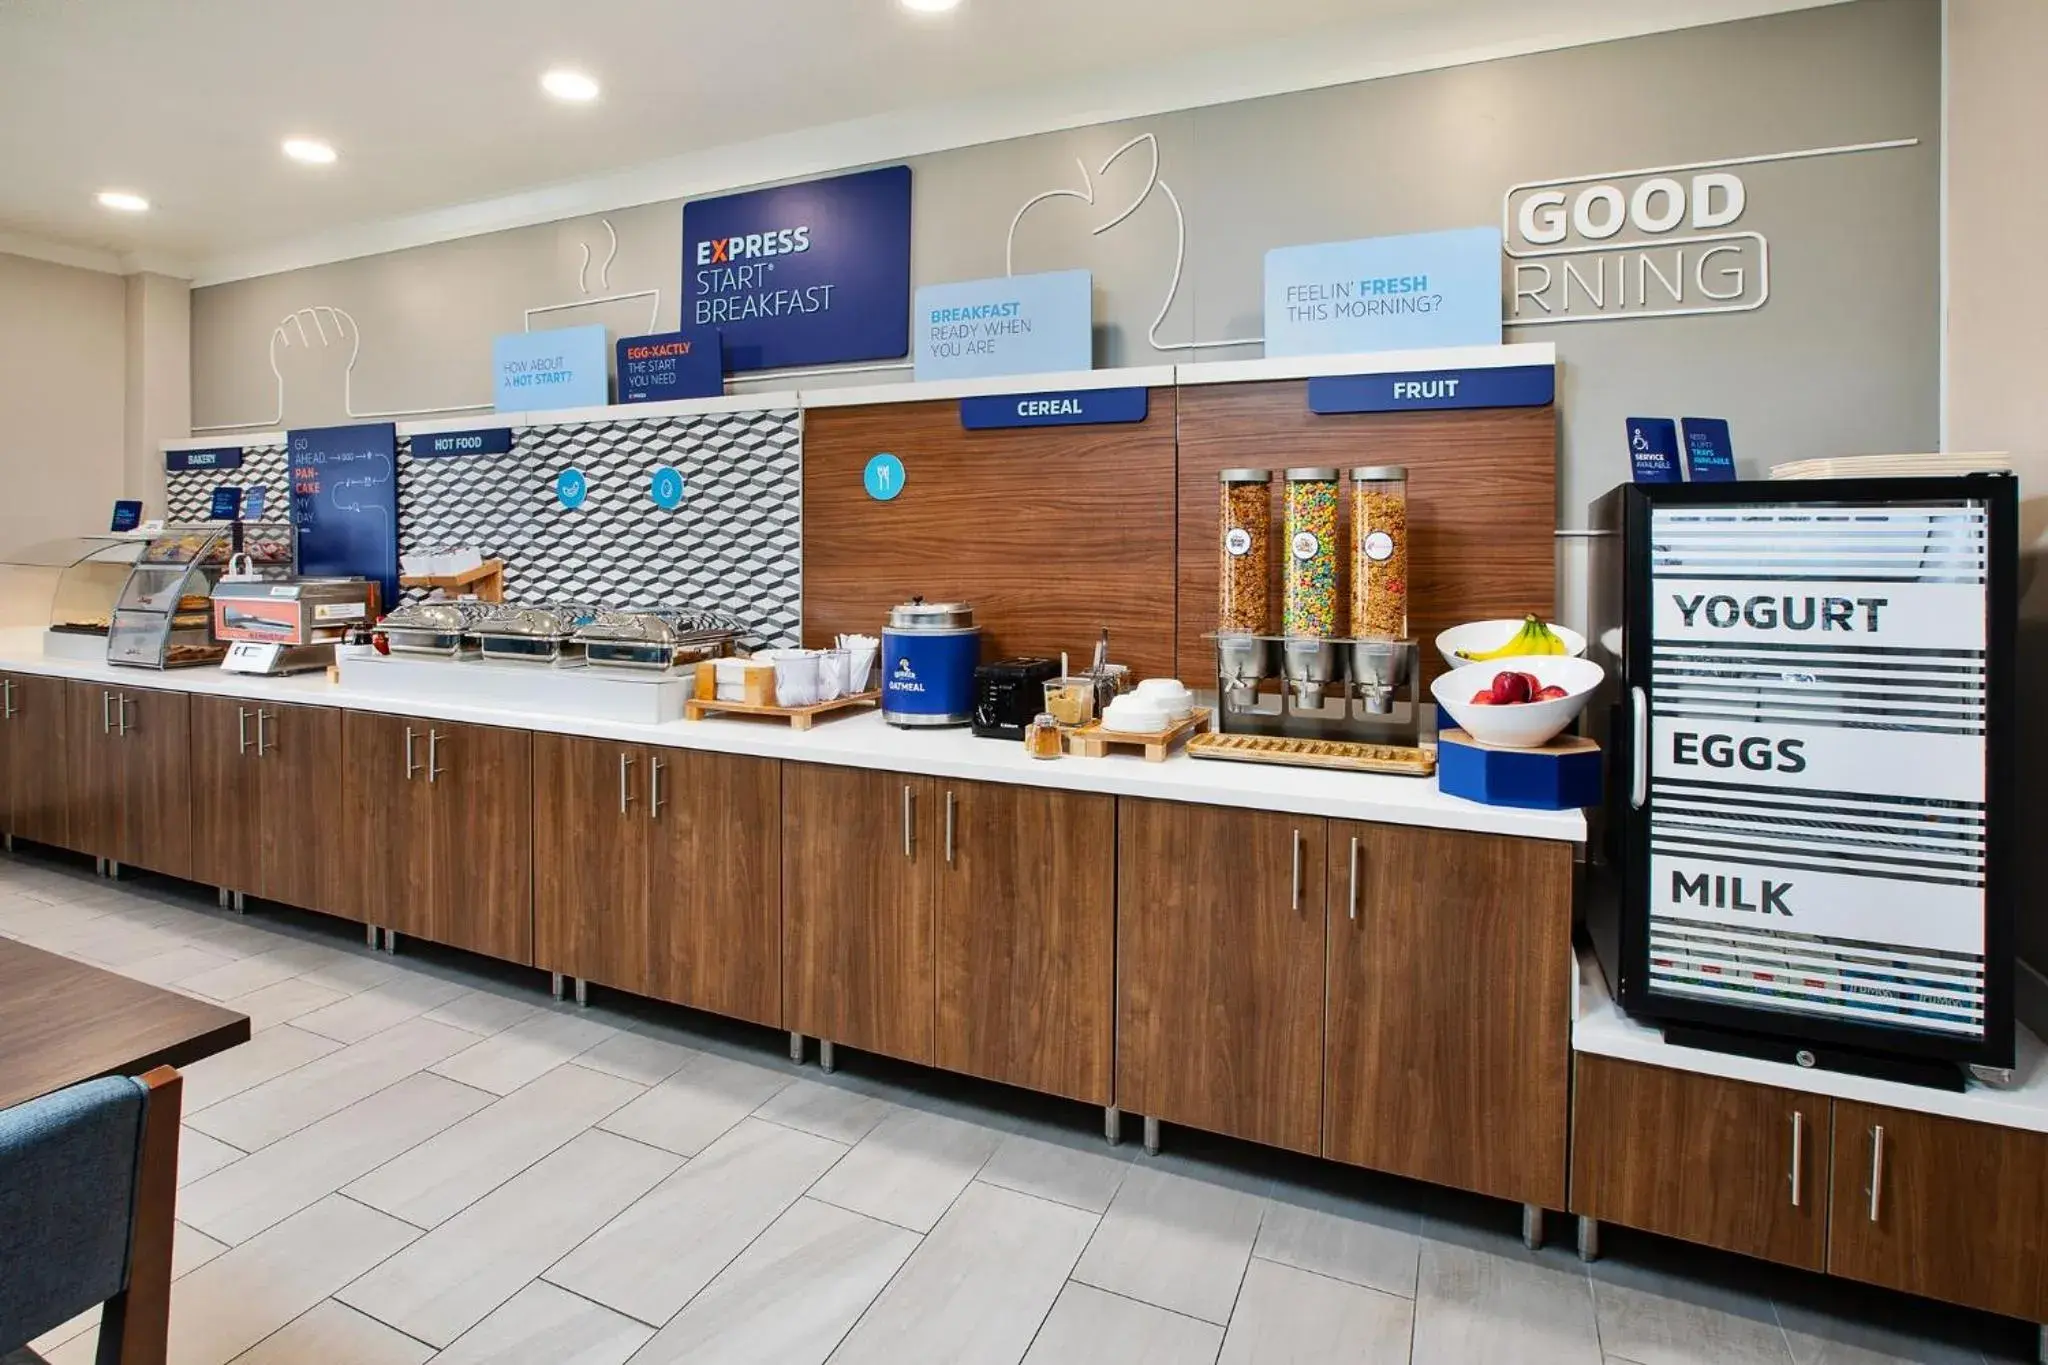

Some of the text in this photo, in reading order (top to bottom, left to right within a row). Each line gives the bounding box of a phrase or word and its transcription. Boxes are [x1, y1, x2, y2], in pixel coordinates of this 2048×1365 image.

[1519, 173, 1745, 244] GOOD
[697, 226, 809, 265] EXPRESS
[1287, 275, 1427, 303] FEELIN' FRESH
[1513, 245, 1744, 316] RNING
[696, 284, 835, 324] BREAKFAST
[931, 302, 1020, 324] BREAKFAST
[1287, 294, 1443, 322] THIS MORNING?
[931, 318, 1032, 341] READY WHEN
[627, 342, 690, 359] EGG-XACTLY
[930, 339, 995, 358] YOU ARE
[504, 356, 564, 373] HOW ABOUT
[628, 358, 676, 374] THE START
[505, 371, 573, 387] A HOT START?
[629, 371, 676, 387] YOU NEED
[1393, 380, 1459, 400] FRUIT
[1017, 399, 1083, 416] CEREAL
[294, 438, 308, 450] GO
[434, 436, 482, 451] HOT FOOD
[188, 454, 216, 465] BAKERY
[1635, 453, 1665, 461] SERVICE
[295, 467, 319, 479] PAN-
[295, 482, 320, 494] CAKE
[1672, 595, 1888, 632] YOGURT
[889, 681, 925, 692] OATMEAL
[1673, 731, 1807, 773] EGGS
[1672, 870, 1794, 916] MILK
